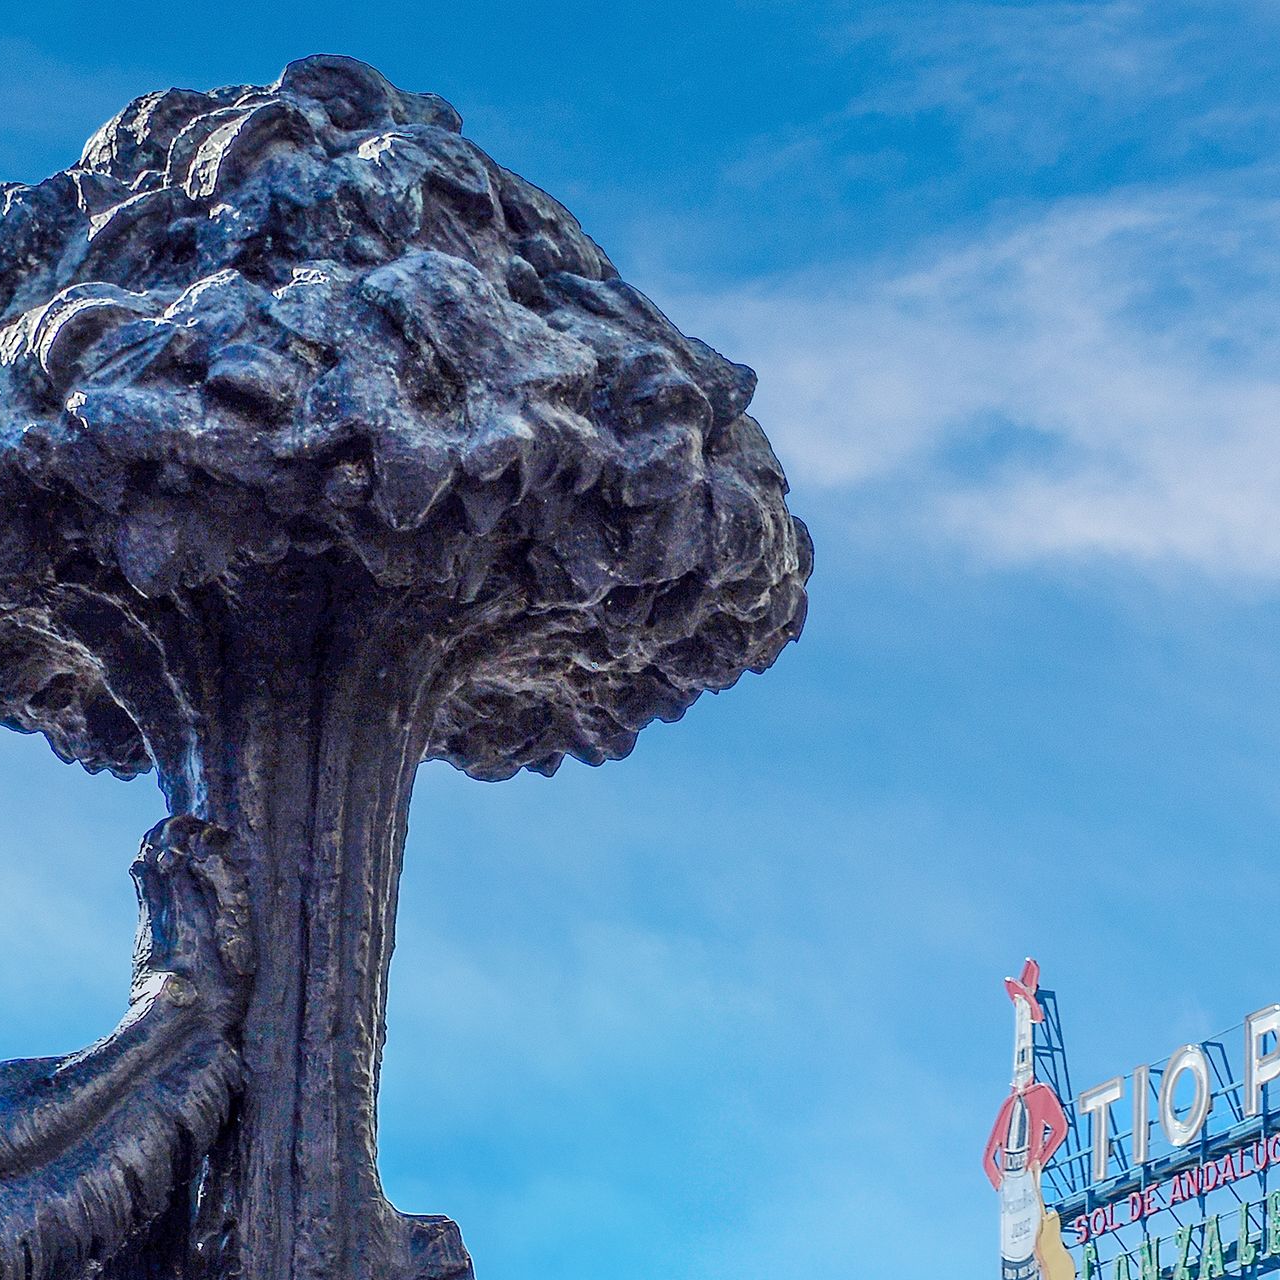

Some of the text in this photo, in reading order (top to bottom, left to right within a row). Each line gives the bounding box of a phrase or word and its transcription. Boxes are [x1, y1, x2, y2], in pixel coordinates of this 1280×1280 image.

[1079, 1043, 1210, 1182] TIO
[1075, 1203, 1123, 1244] SOL
[1128, 1183, 1161, 1222] DE
